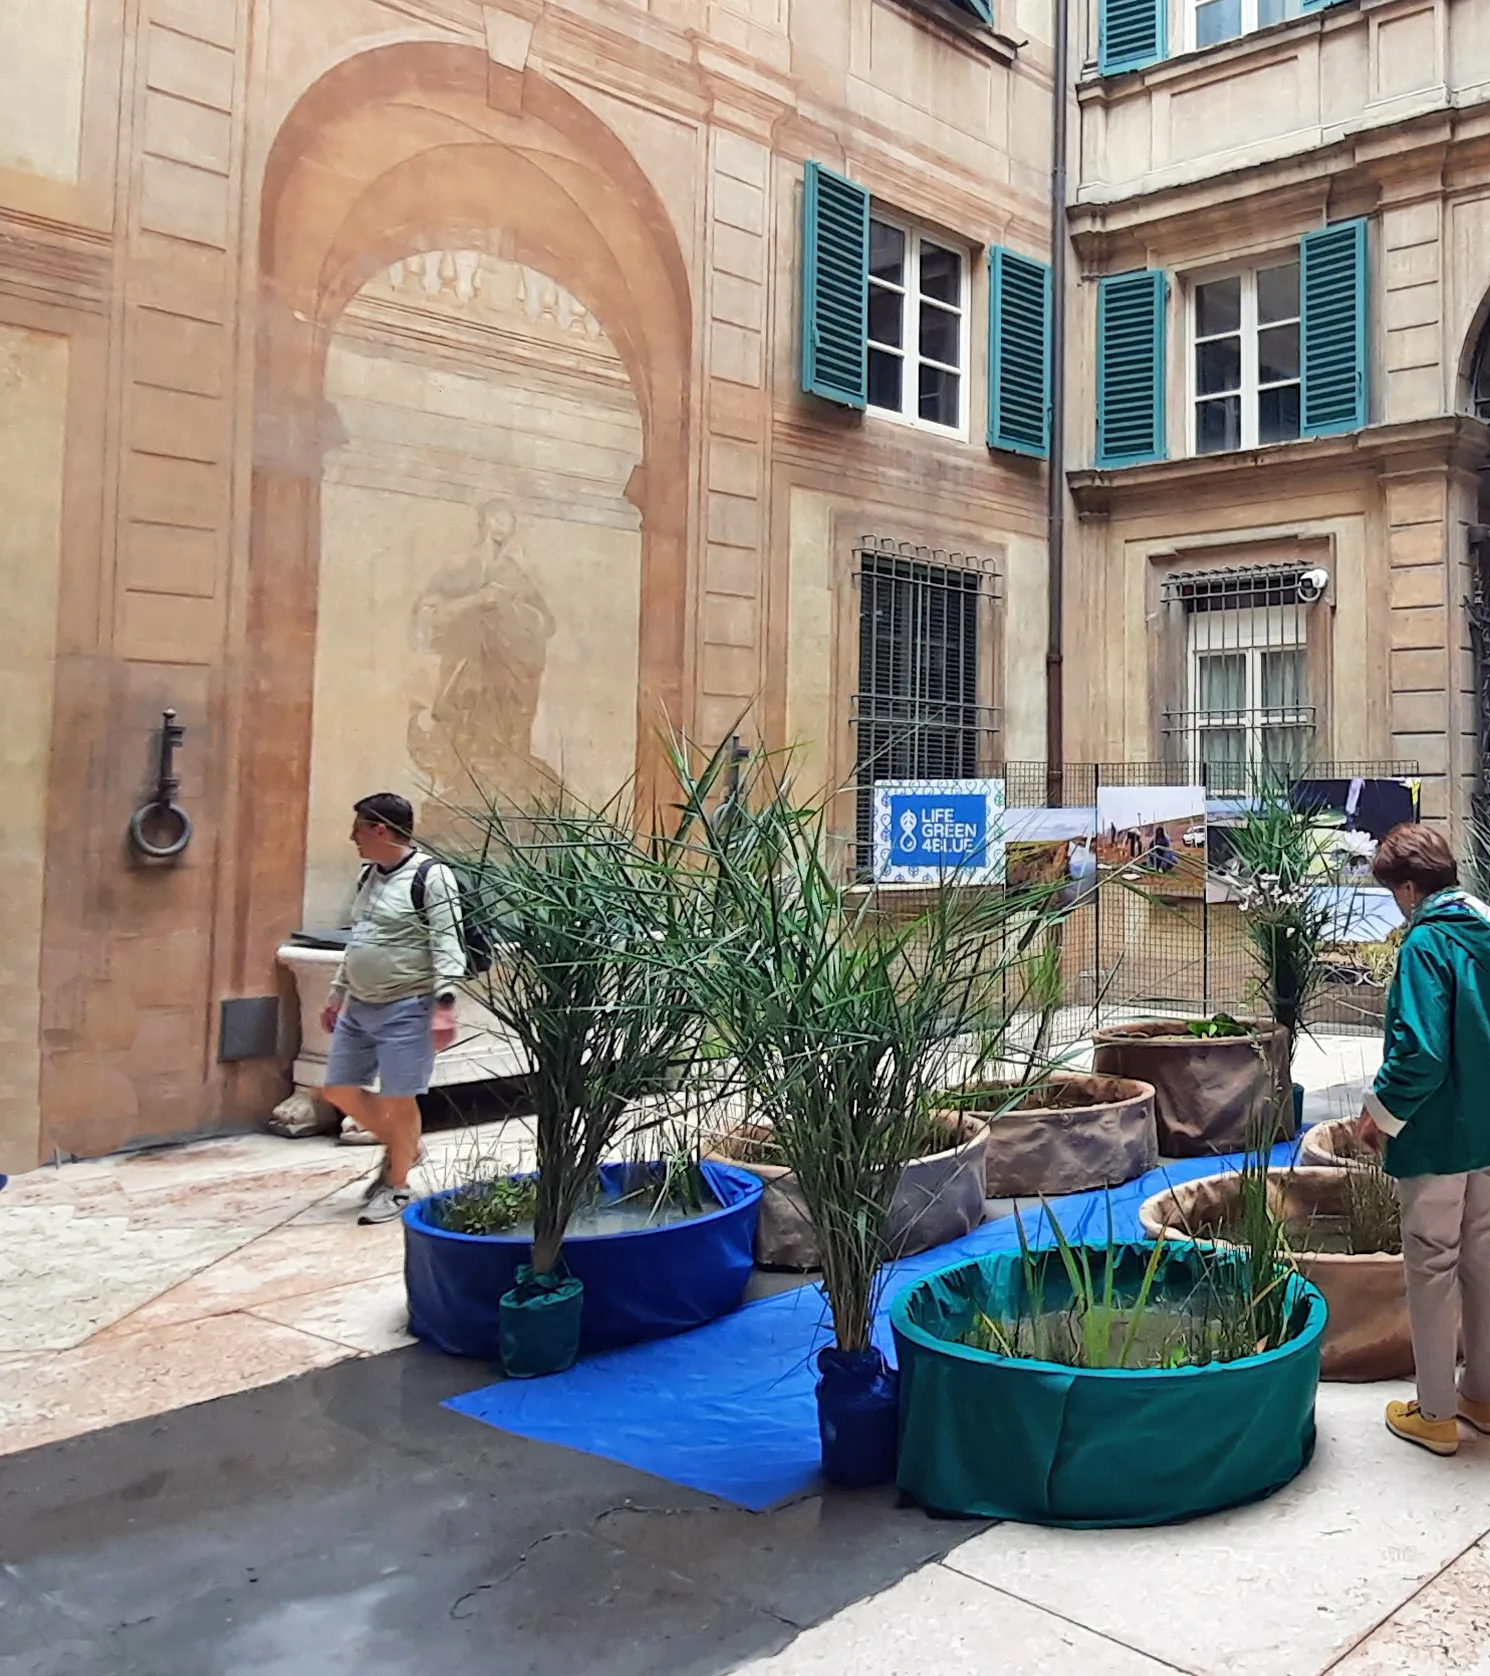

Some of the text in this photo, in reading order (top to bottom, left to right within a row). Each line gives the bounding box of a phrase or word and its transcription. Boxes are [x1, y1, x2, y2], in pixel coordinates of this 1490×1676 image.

[921, 808, 955, 823] LIFE
[921, 823, 977, 838] GREEN
[921, 838, 974, 853] 4BLUE
